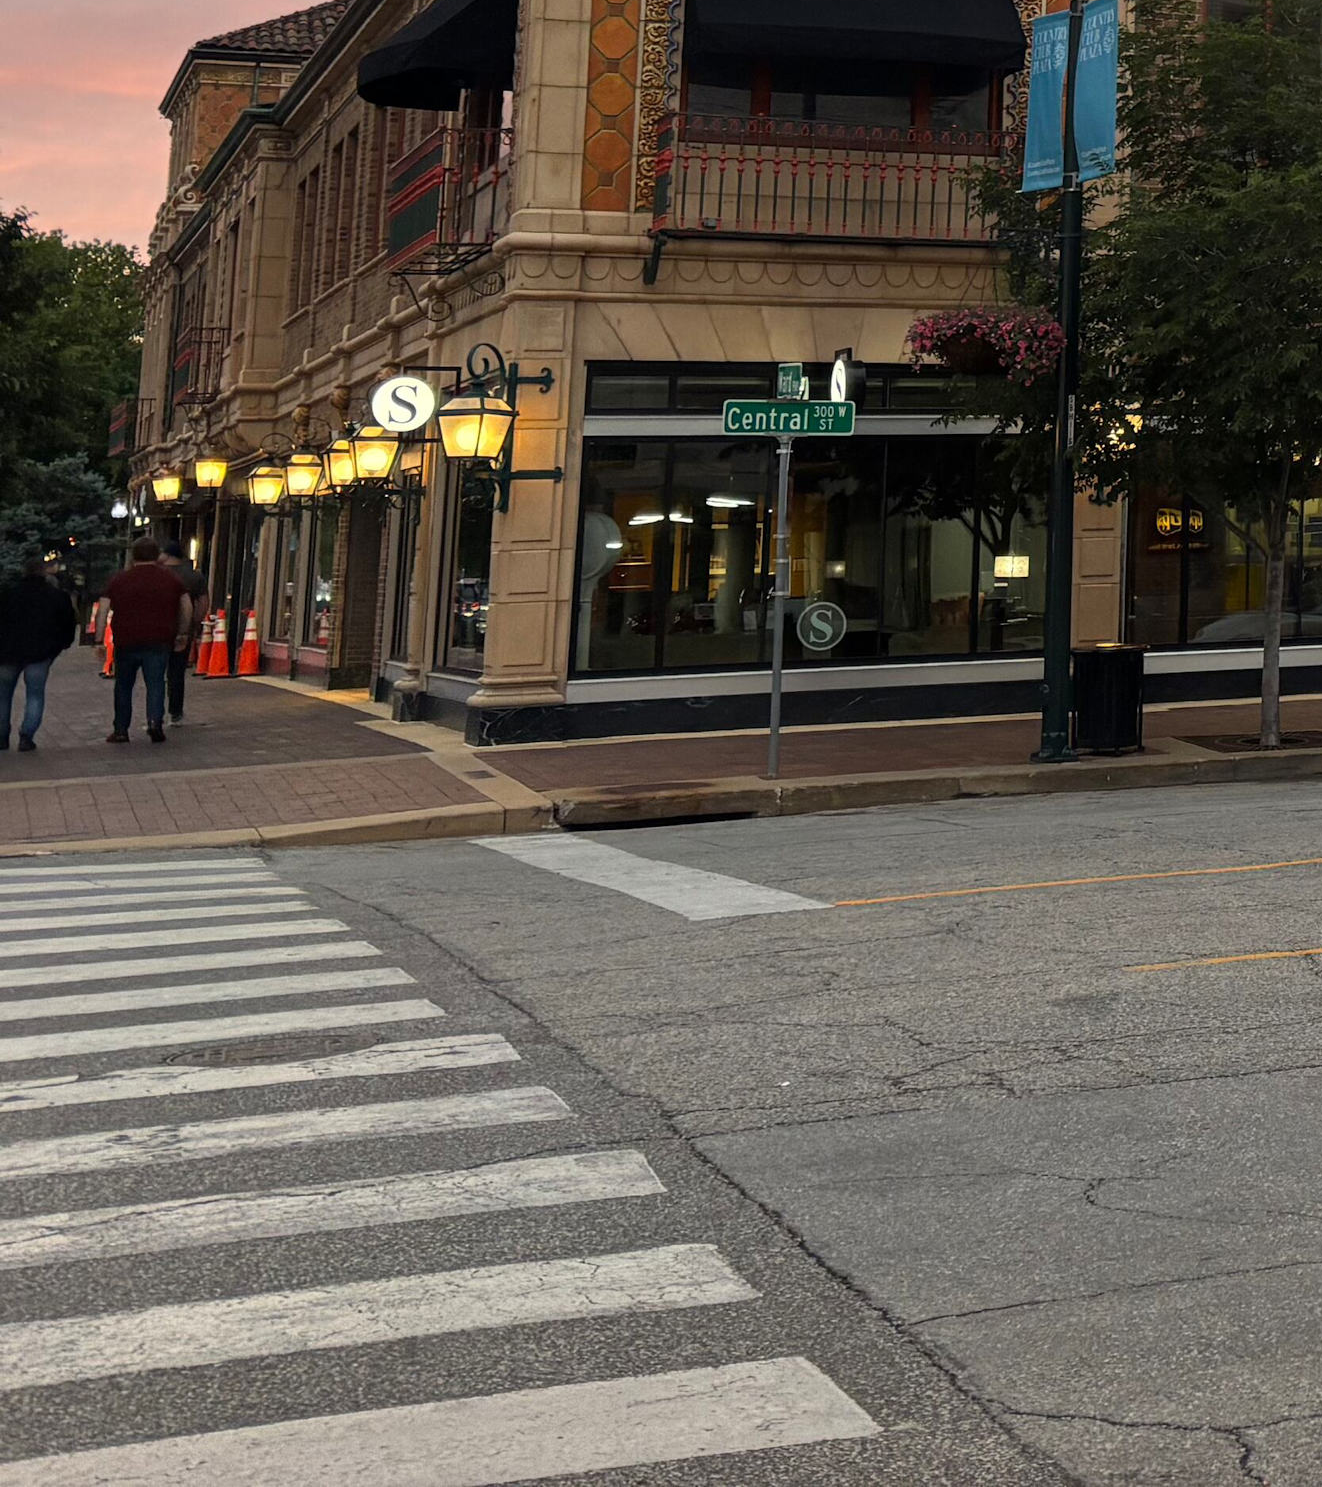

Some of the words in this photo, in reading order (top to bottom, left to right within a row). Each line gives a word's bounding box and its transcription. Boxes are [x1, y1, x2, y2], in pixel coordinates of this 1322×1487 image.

[388, 385, 417, 424] S
[727, 407, 809, 431] Central
[813, 406, 835, 418] 300
[838, 406, 847, 418] W
[819, 418, 834, 431] ST
